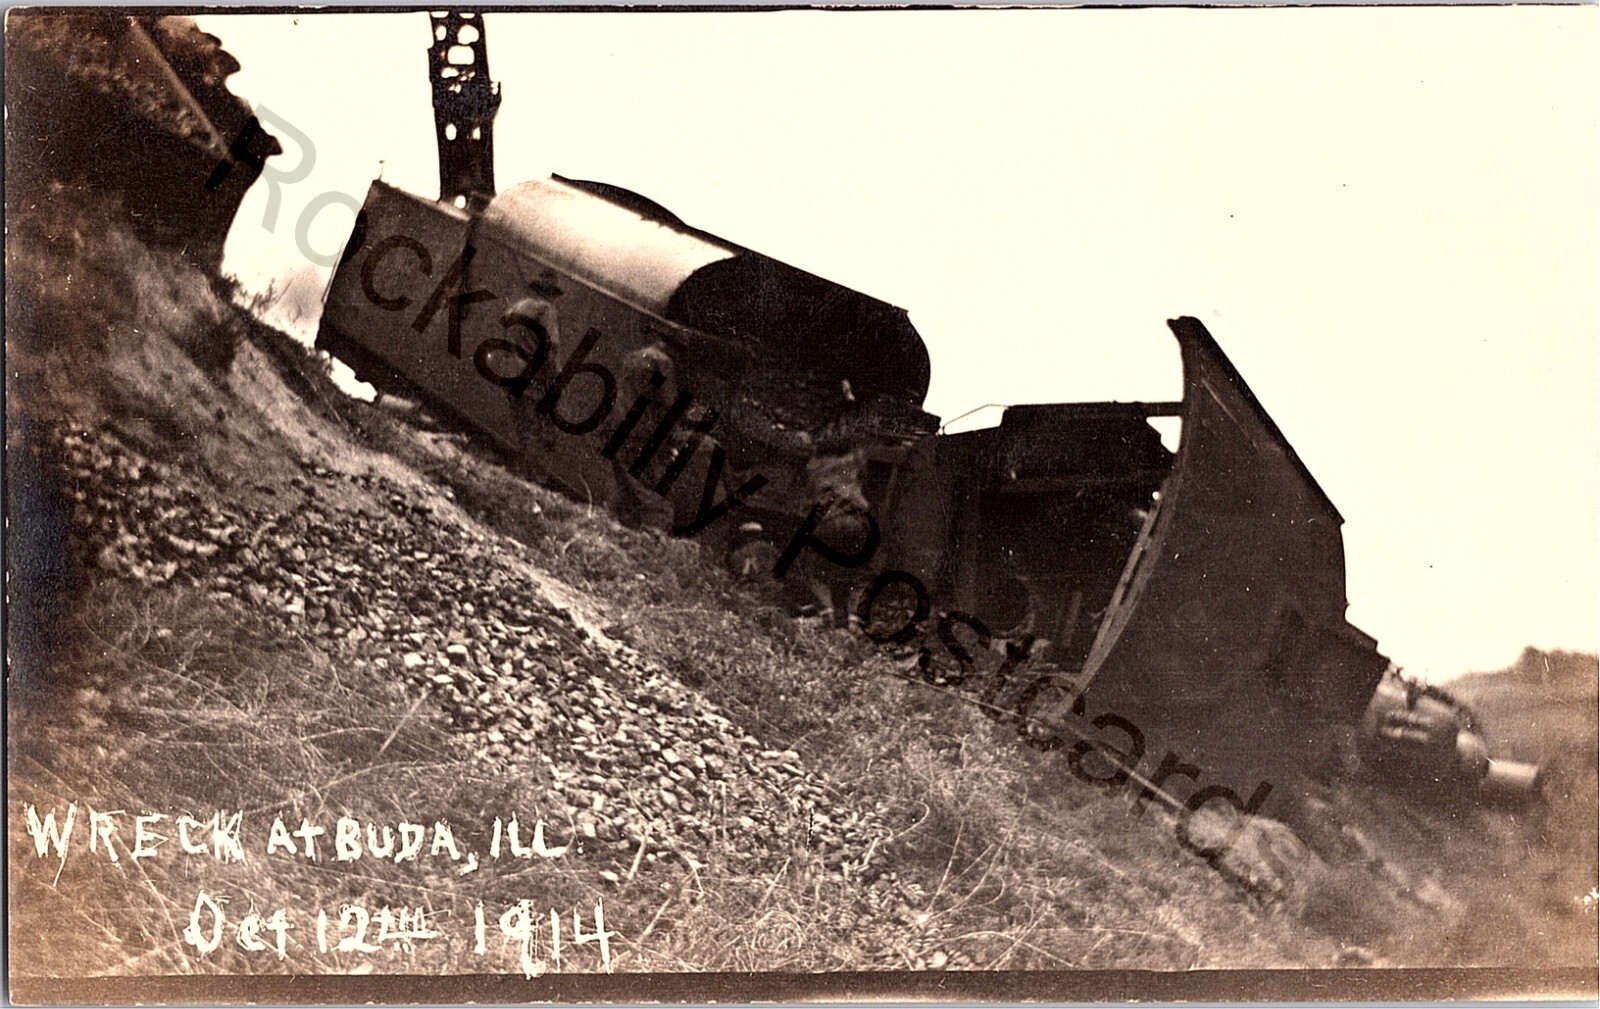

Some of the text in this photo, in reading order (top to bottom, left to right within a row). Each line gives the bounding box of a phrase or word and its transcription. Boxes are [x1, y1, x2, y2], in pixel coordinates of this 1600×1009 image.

[24, 800, 248, 878] WRECK
[332, 815, 479, 876] BUDA,
[183, 890, 295, 960] Oct
[474, 896, 617, 980] 1914
